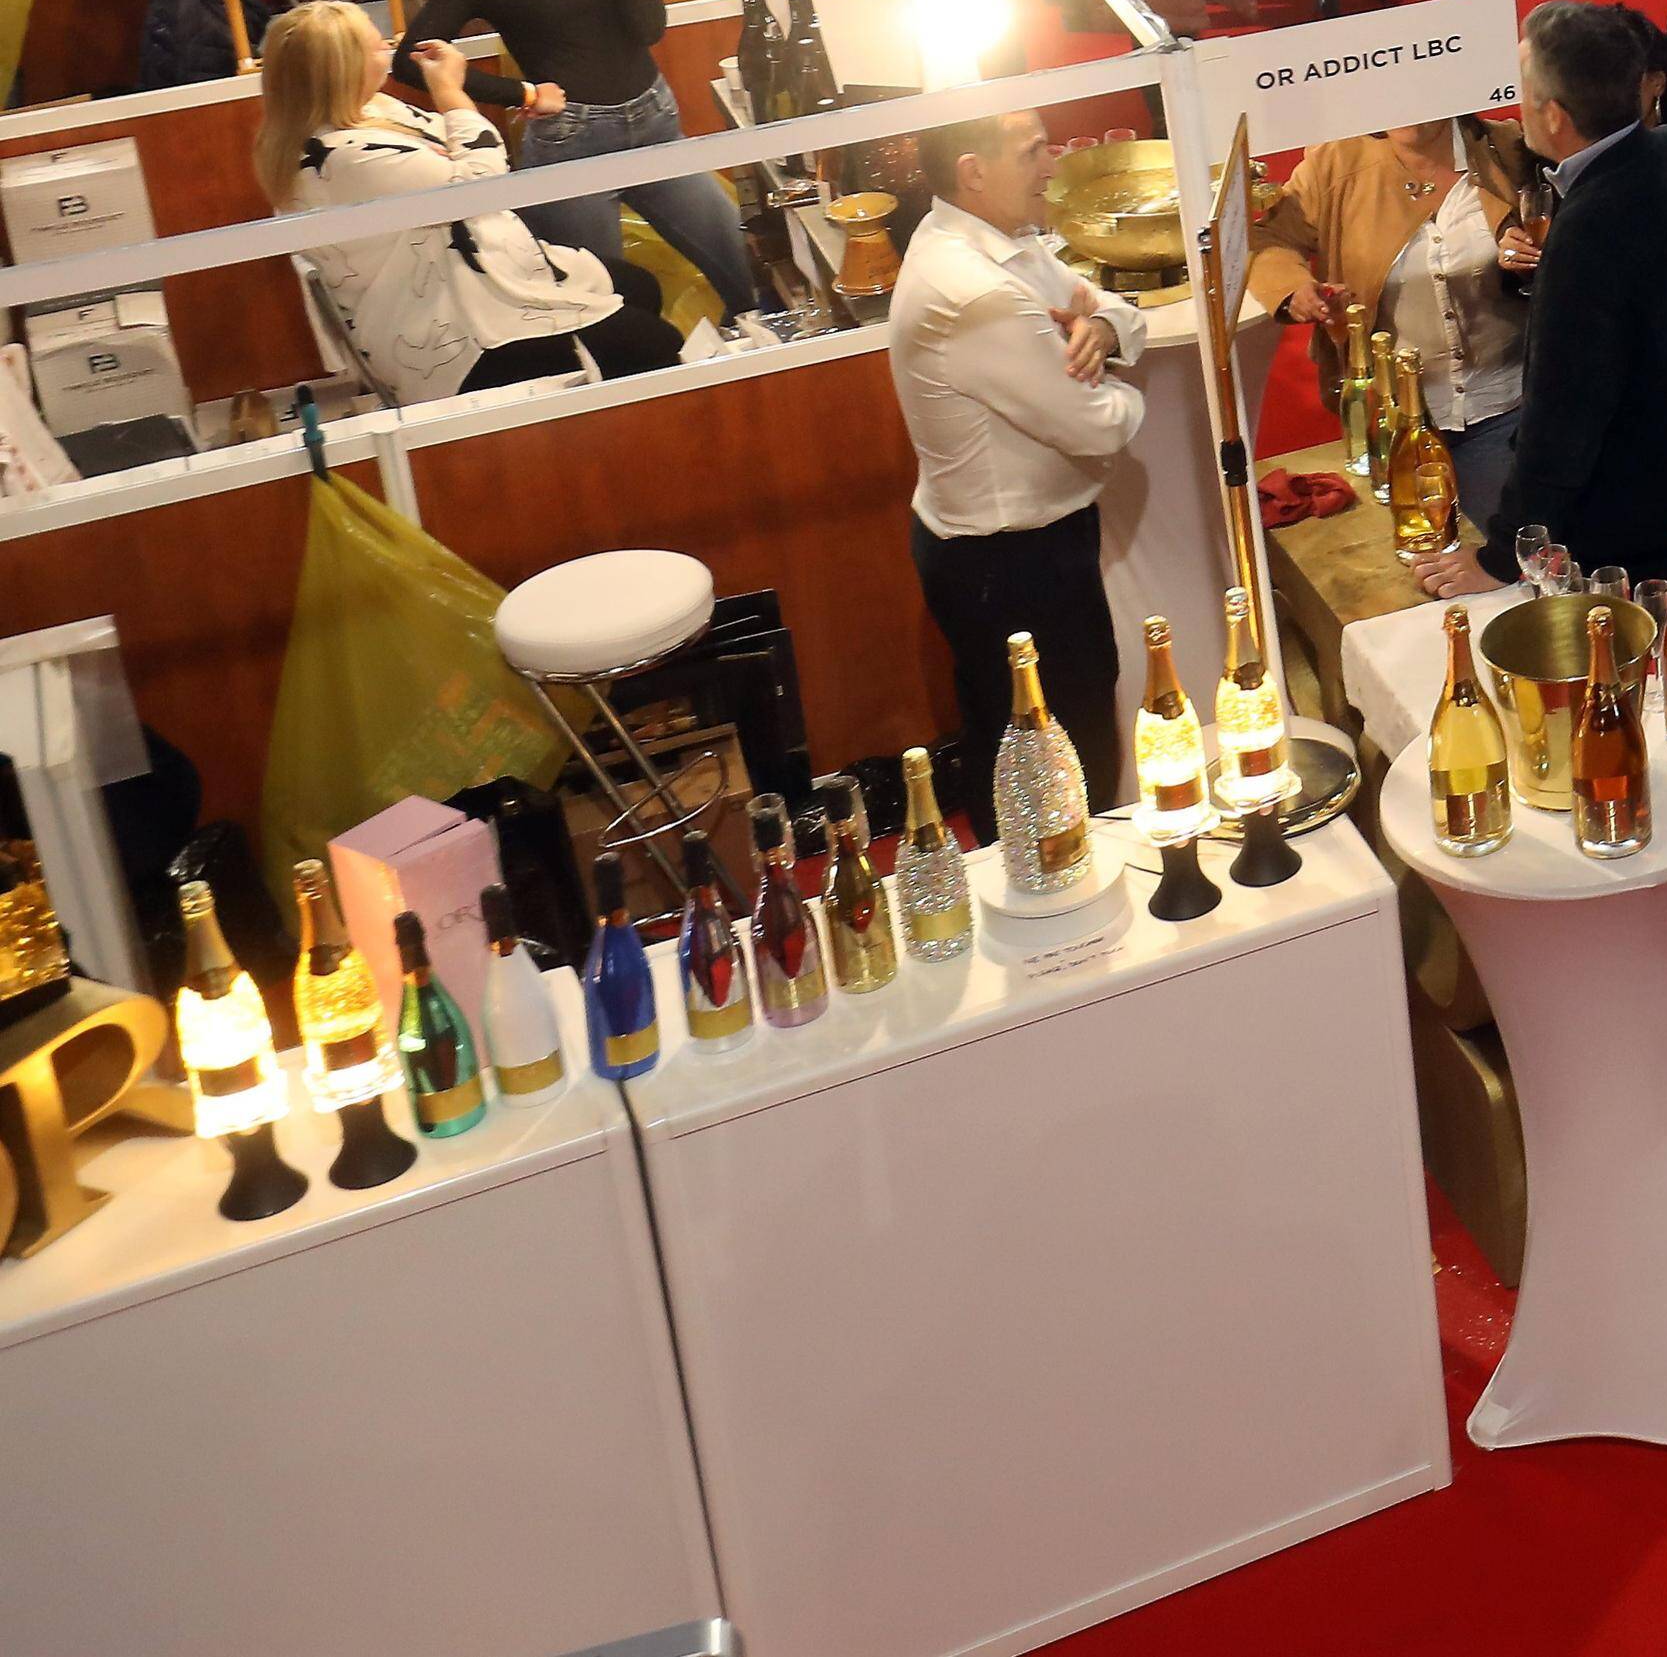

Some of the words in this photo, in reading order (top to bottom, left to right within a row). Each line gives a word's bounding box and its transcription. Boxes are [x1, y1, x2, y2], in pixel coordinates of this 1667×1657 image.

[1256, 68, 1295, 90] OR
[1303, 47, 1403, 82] ADDICT
[1413, 35, 1463, 62] LBC
[1489, 85, 1516, 102] 46
